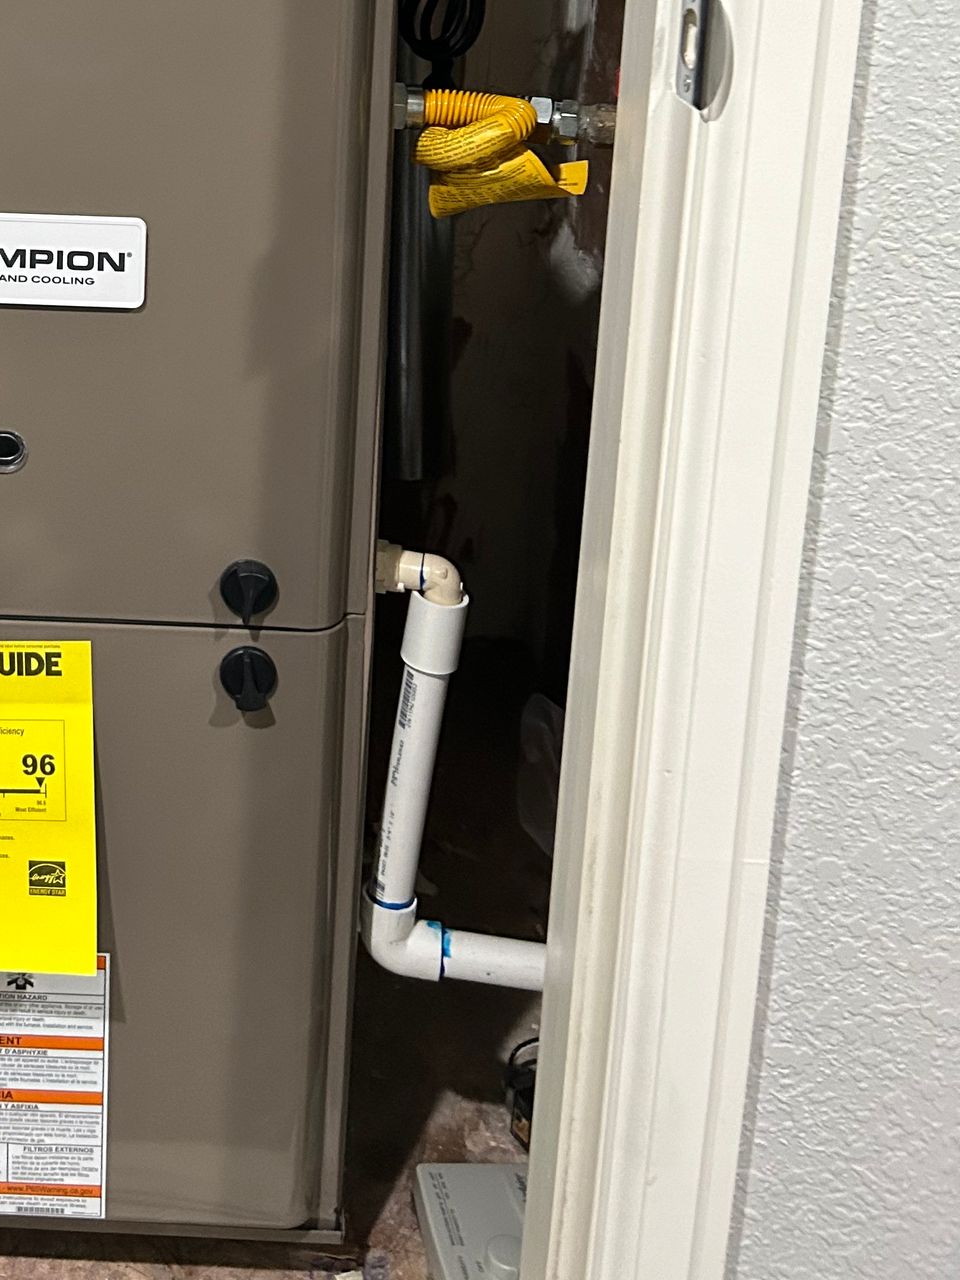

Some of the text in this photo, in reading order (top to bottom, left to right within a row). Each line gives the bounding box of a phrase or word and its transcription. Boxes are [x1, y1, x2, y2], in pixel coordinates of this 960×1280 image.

[31, 275, 95, 285] COOLING
[22, 754, 56, 776] 96
[51, 889, 65, 897] STAR
